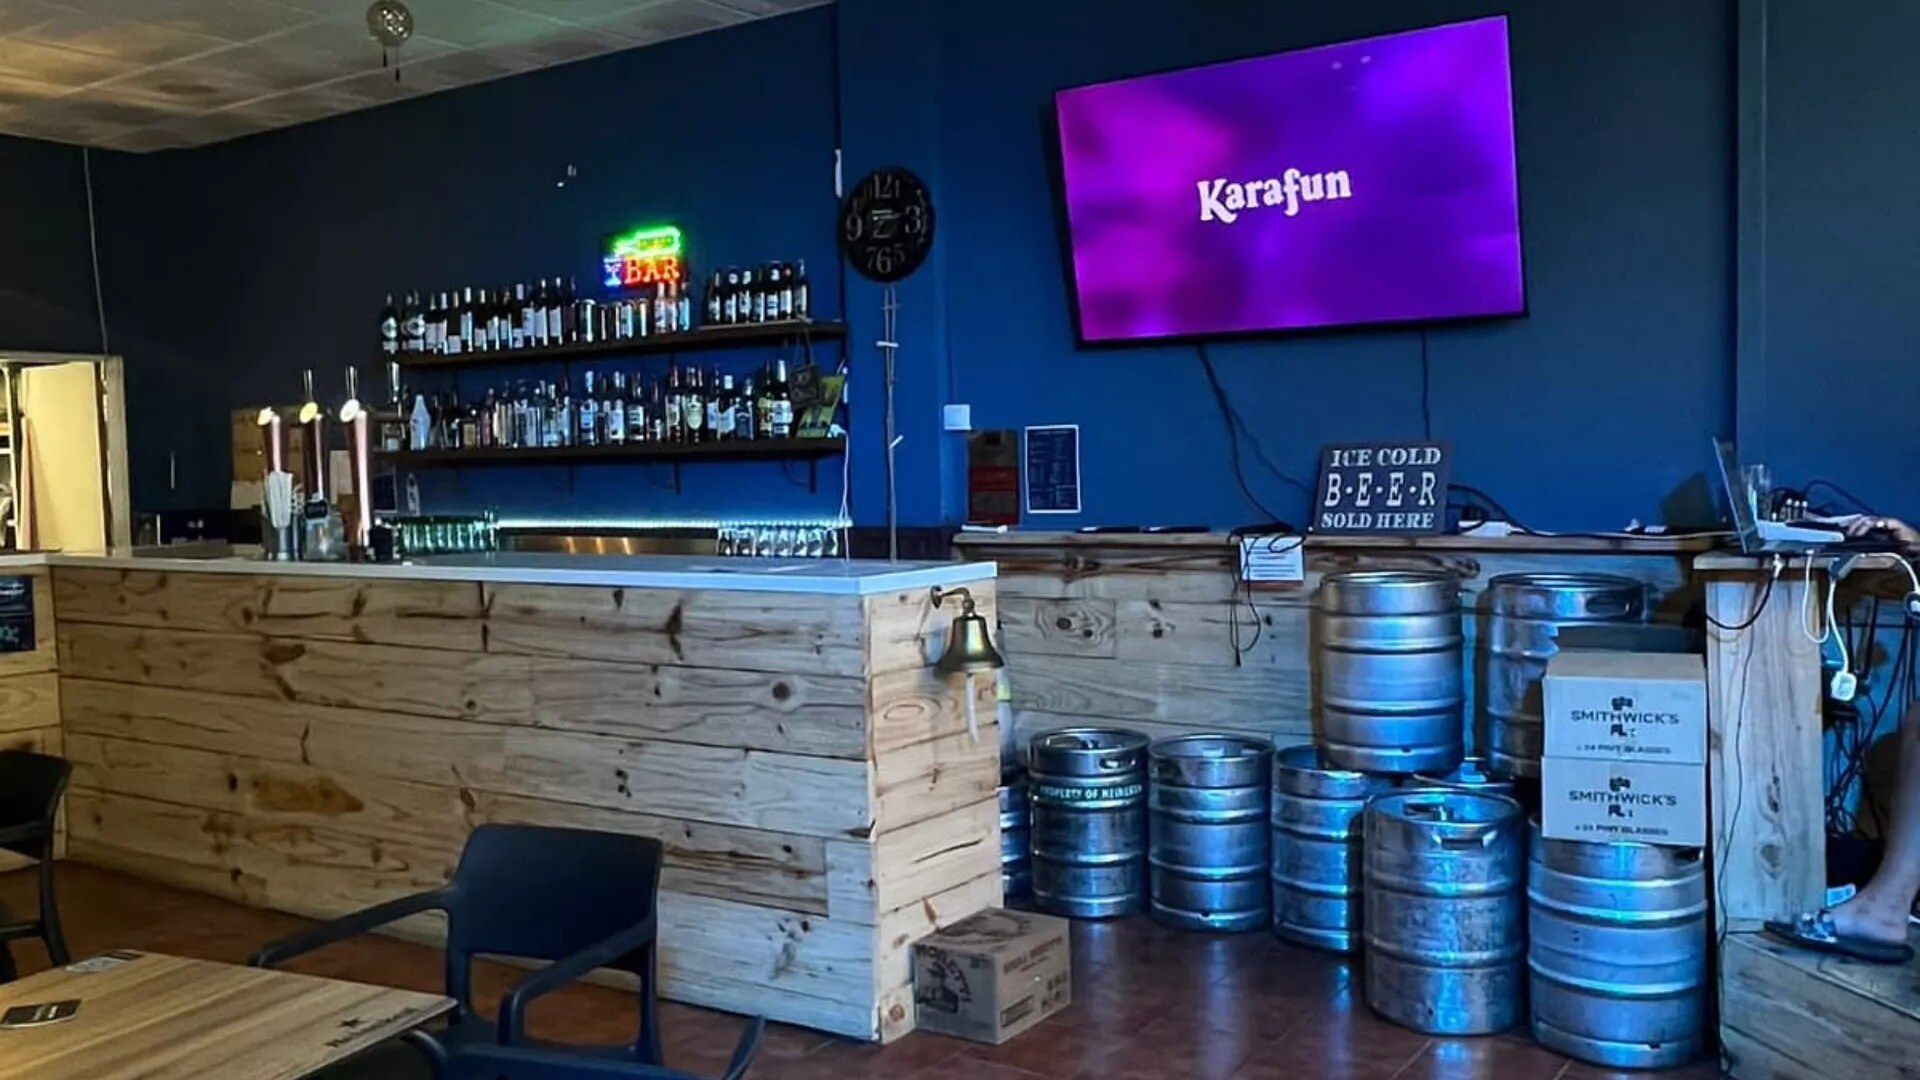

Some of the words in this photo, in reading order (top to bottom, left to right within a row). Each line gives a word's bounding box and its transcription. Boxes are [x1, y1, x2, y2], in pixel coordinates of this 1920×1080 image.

[1197, 168, 1352, 224] Karafun
[624, 255, 680, 285] BAR
[1331, 449, 1372, 467] ICE
[1377, 447, 1441, 467] COLD
[1321, 512, 1372, 528] SOLD
[1375, 512, 1435, 529] HERE
[1570, 709, 1680, 725] SMITHWICK'S
[1085, 788, 1099, 799] OF
[1568, 790, 1677, 807] SMITHWICK'S
